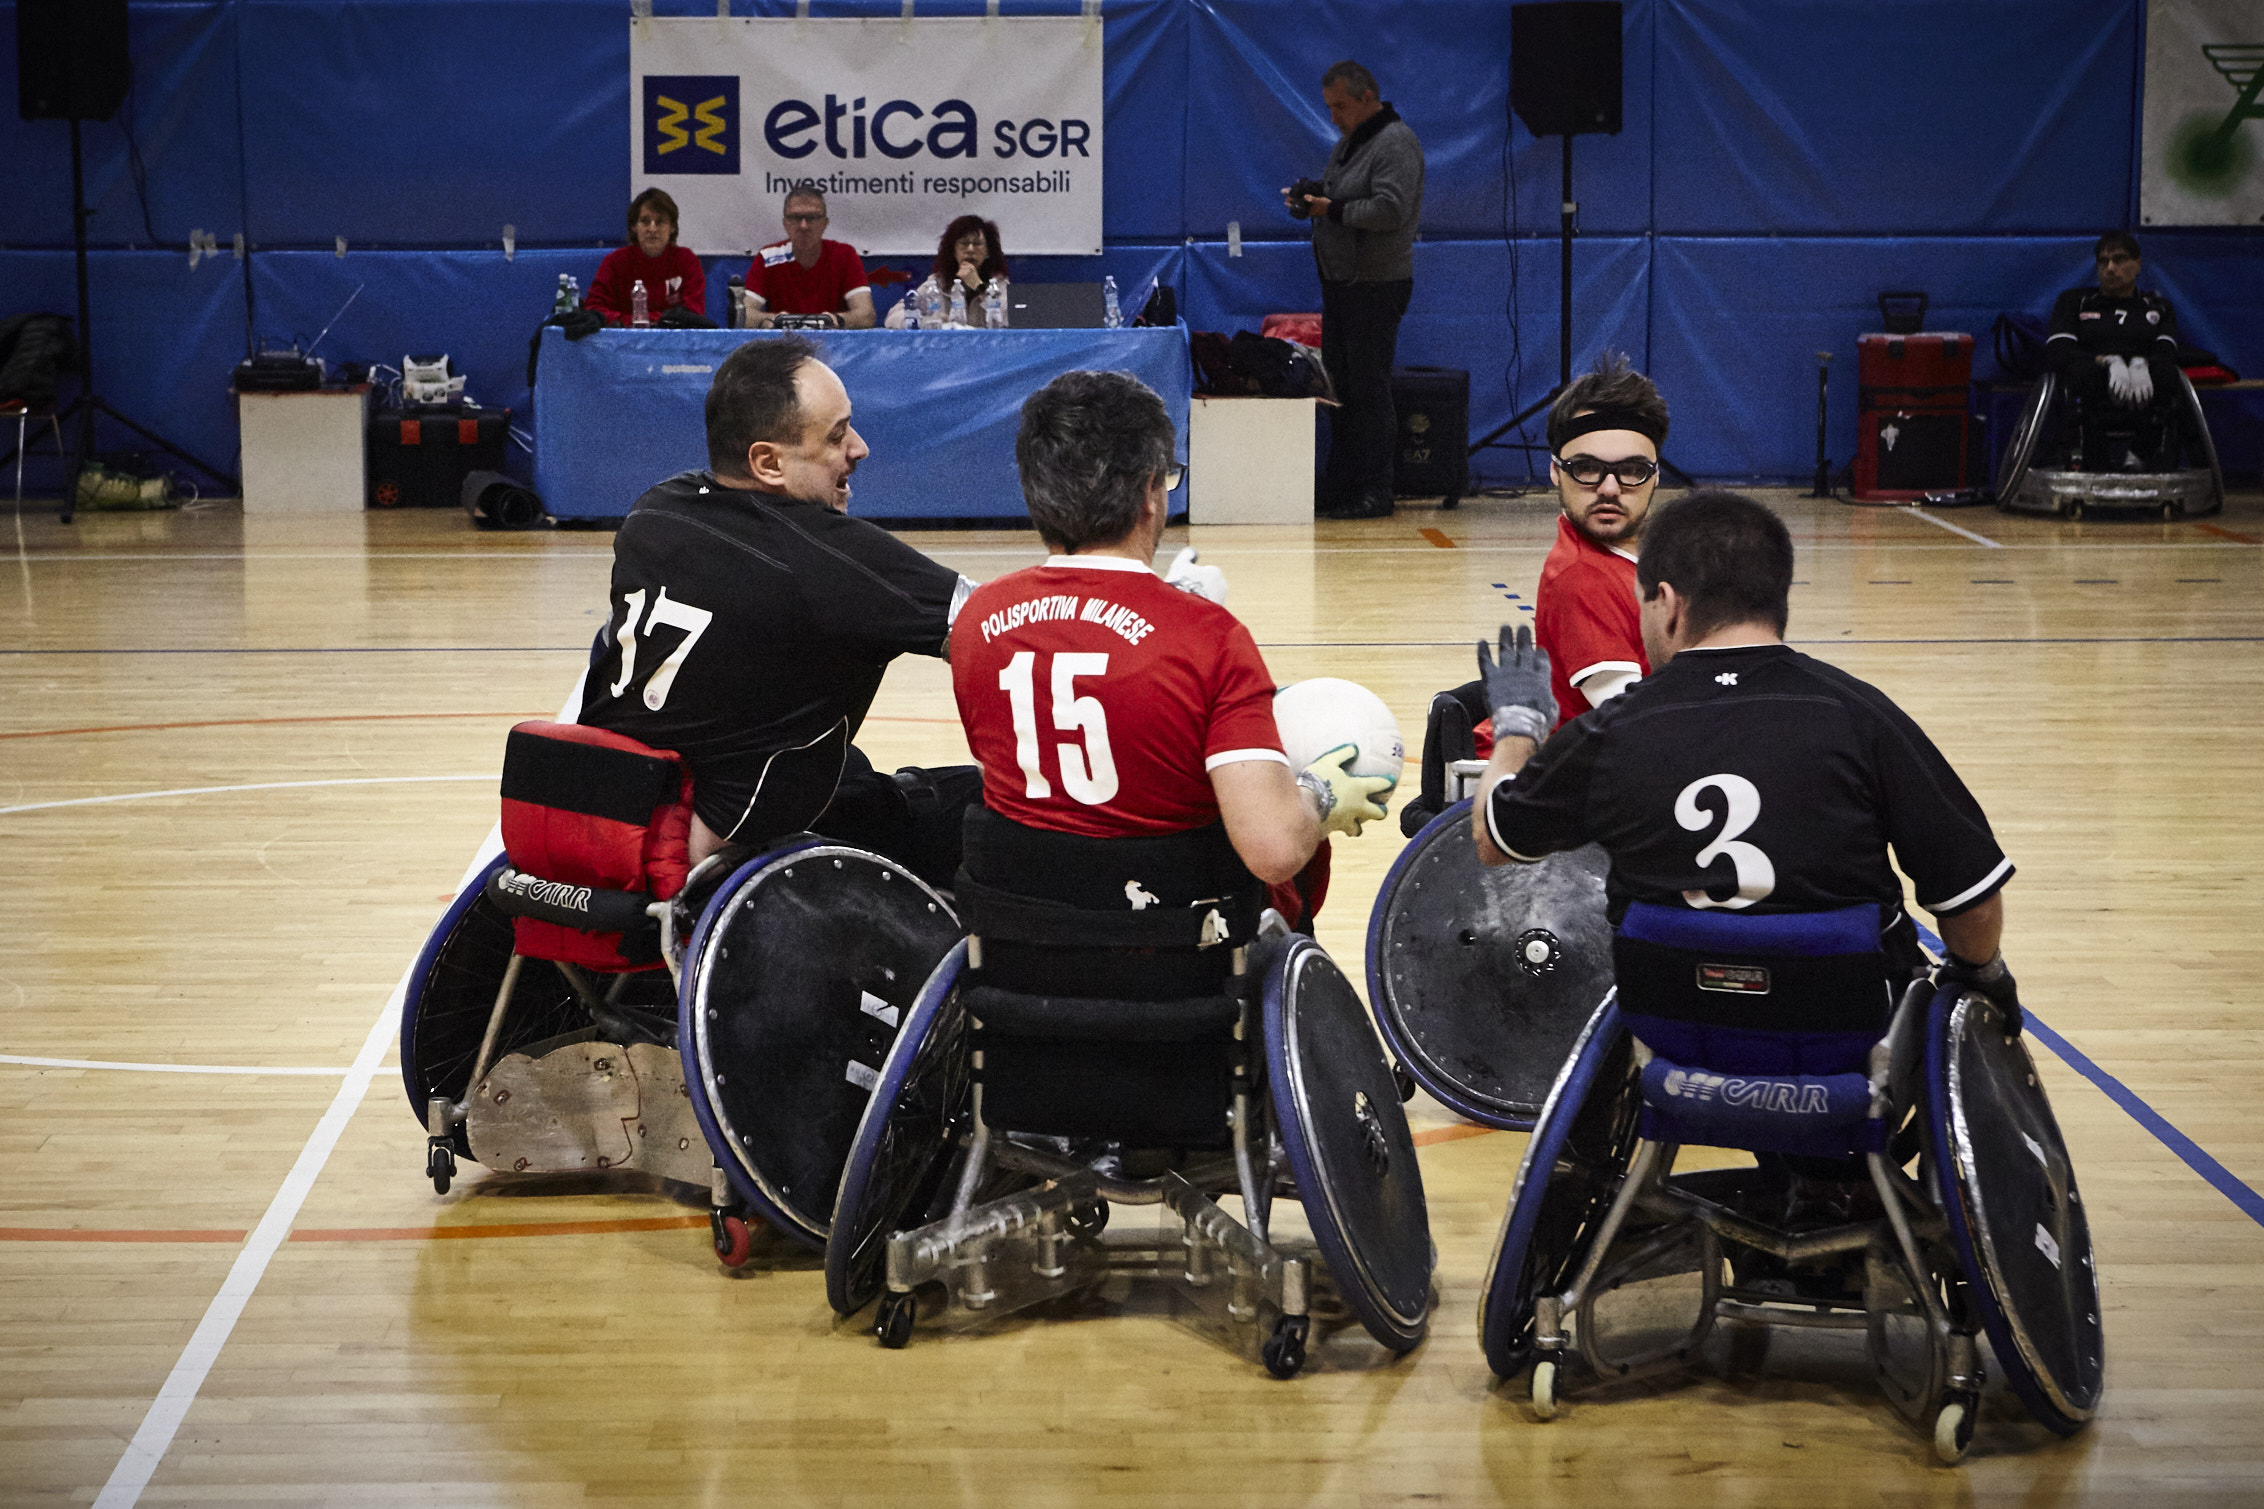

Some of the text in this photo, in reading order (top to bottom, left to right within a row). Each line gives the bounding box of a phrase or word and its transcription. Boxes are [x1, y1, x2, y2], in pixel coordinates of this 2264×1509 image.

[764, 94, 1090, 159] etica SGR
[766, 171, 1070, 198] Investimenti responsabili
[2114, 309, 2128, 325] 7
[611, 586, 713, 711] 17
[981, 595, 1155, 645] POLISPORTIVA MILANESE
[999, 651, 1119, 805] 15
[1674, 773, 1776, 909] 3
